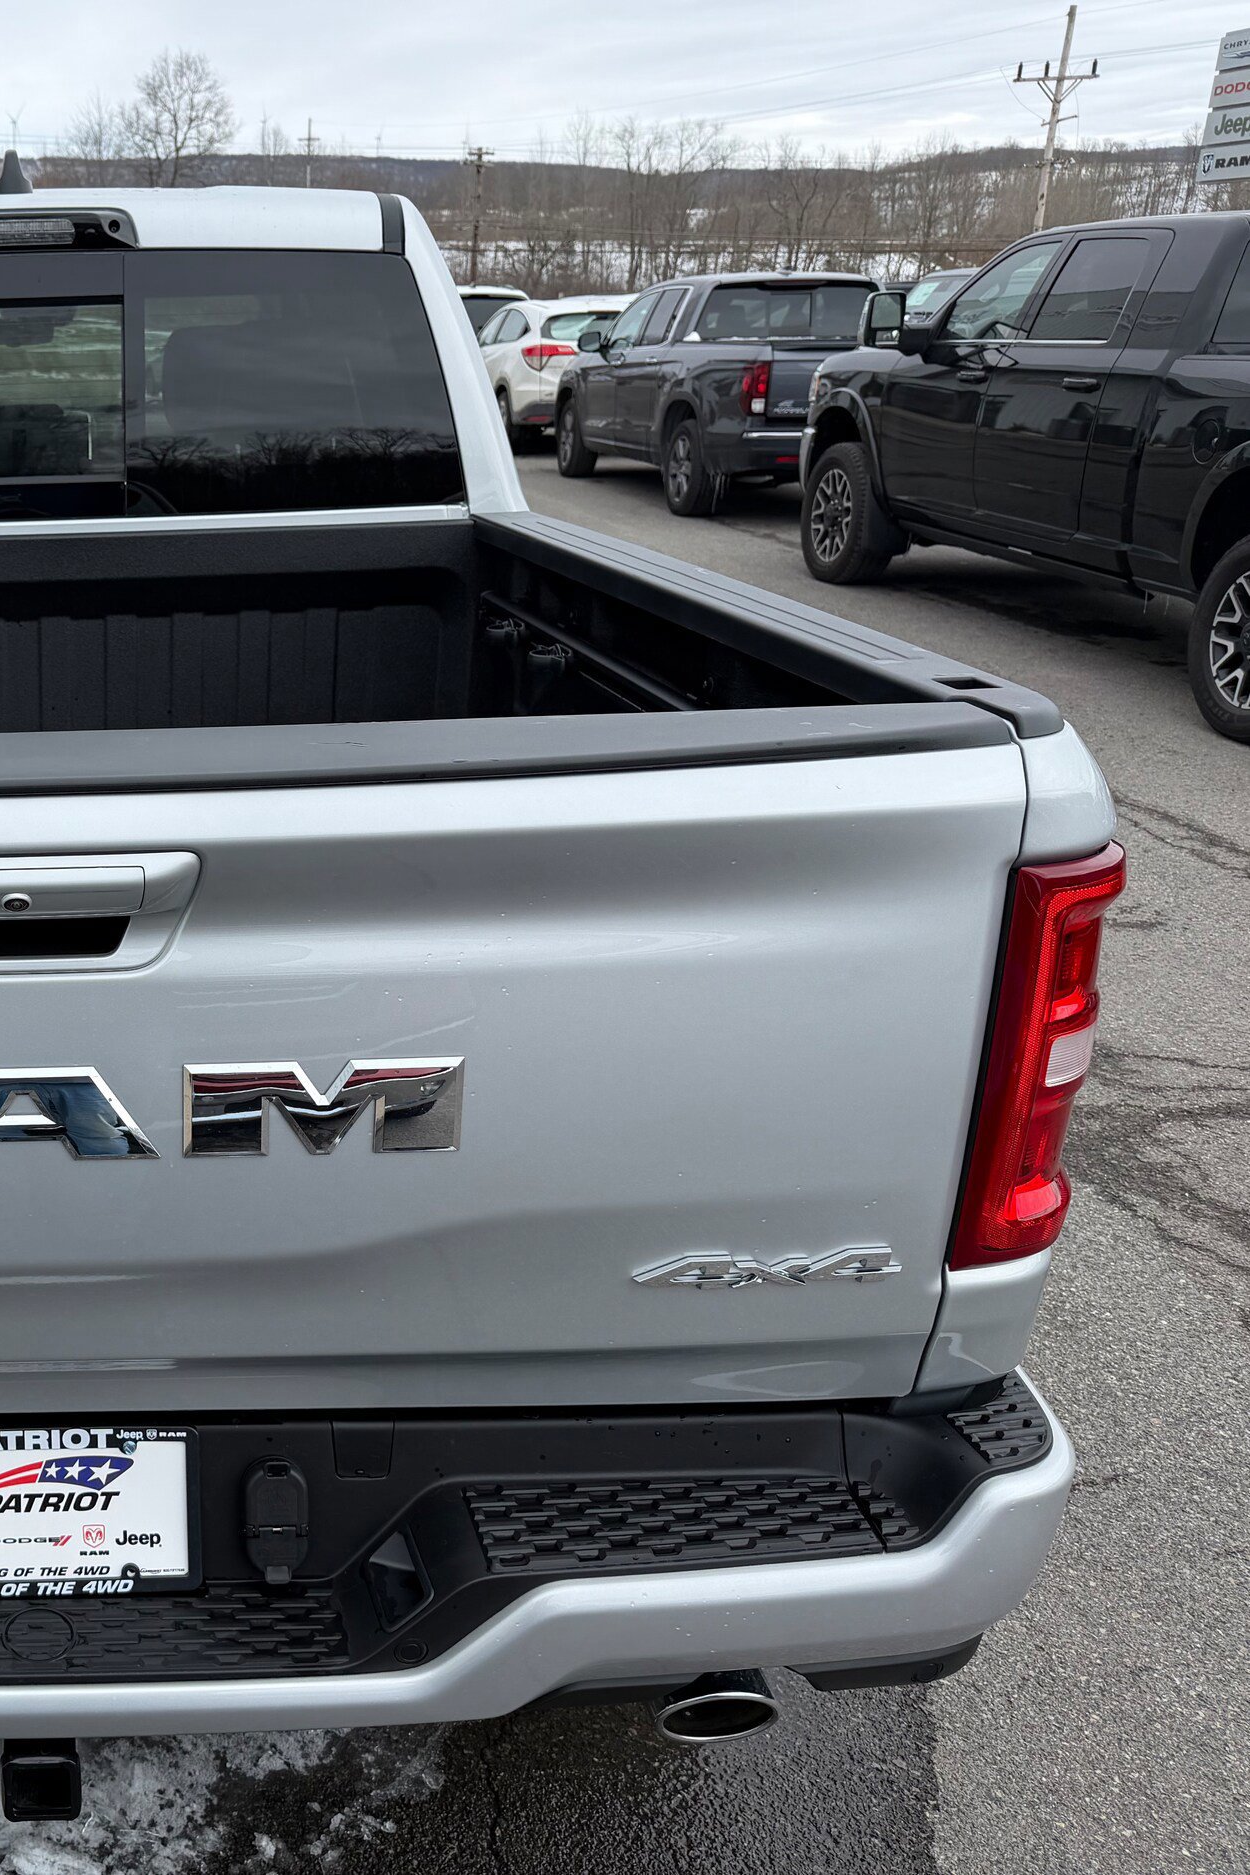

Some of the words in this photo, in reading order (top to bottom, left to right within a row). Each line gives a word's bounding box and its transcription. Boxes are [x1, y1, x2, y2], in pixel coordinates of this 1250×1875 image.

[116, 1429, 144, 1440] Jeep
[114, 1529, 162, 1548] Jeep
[13, 1567, 34, 1578] OF
[40, 1566, 68, 1577] THE
[73, 1565, 111, 1576] 4WD
[0, 1582, 30, 1597] OF
[37, 1580, 76, 1596] THE
[82, 1579, 134, 1594] 4WD
